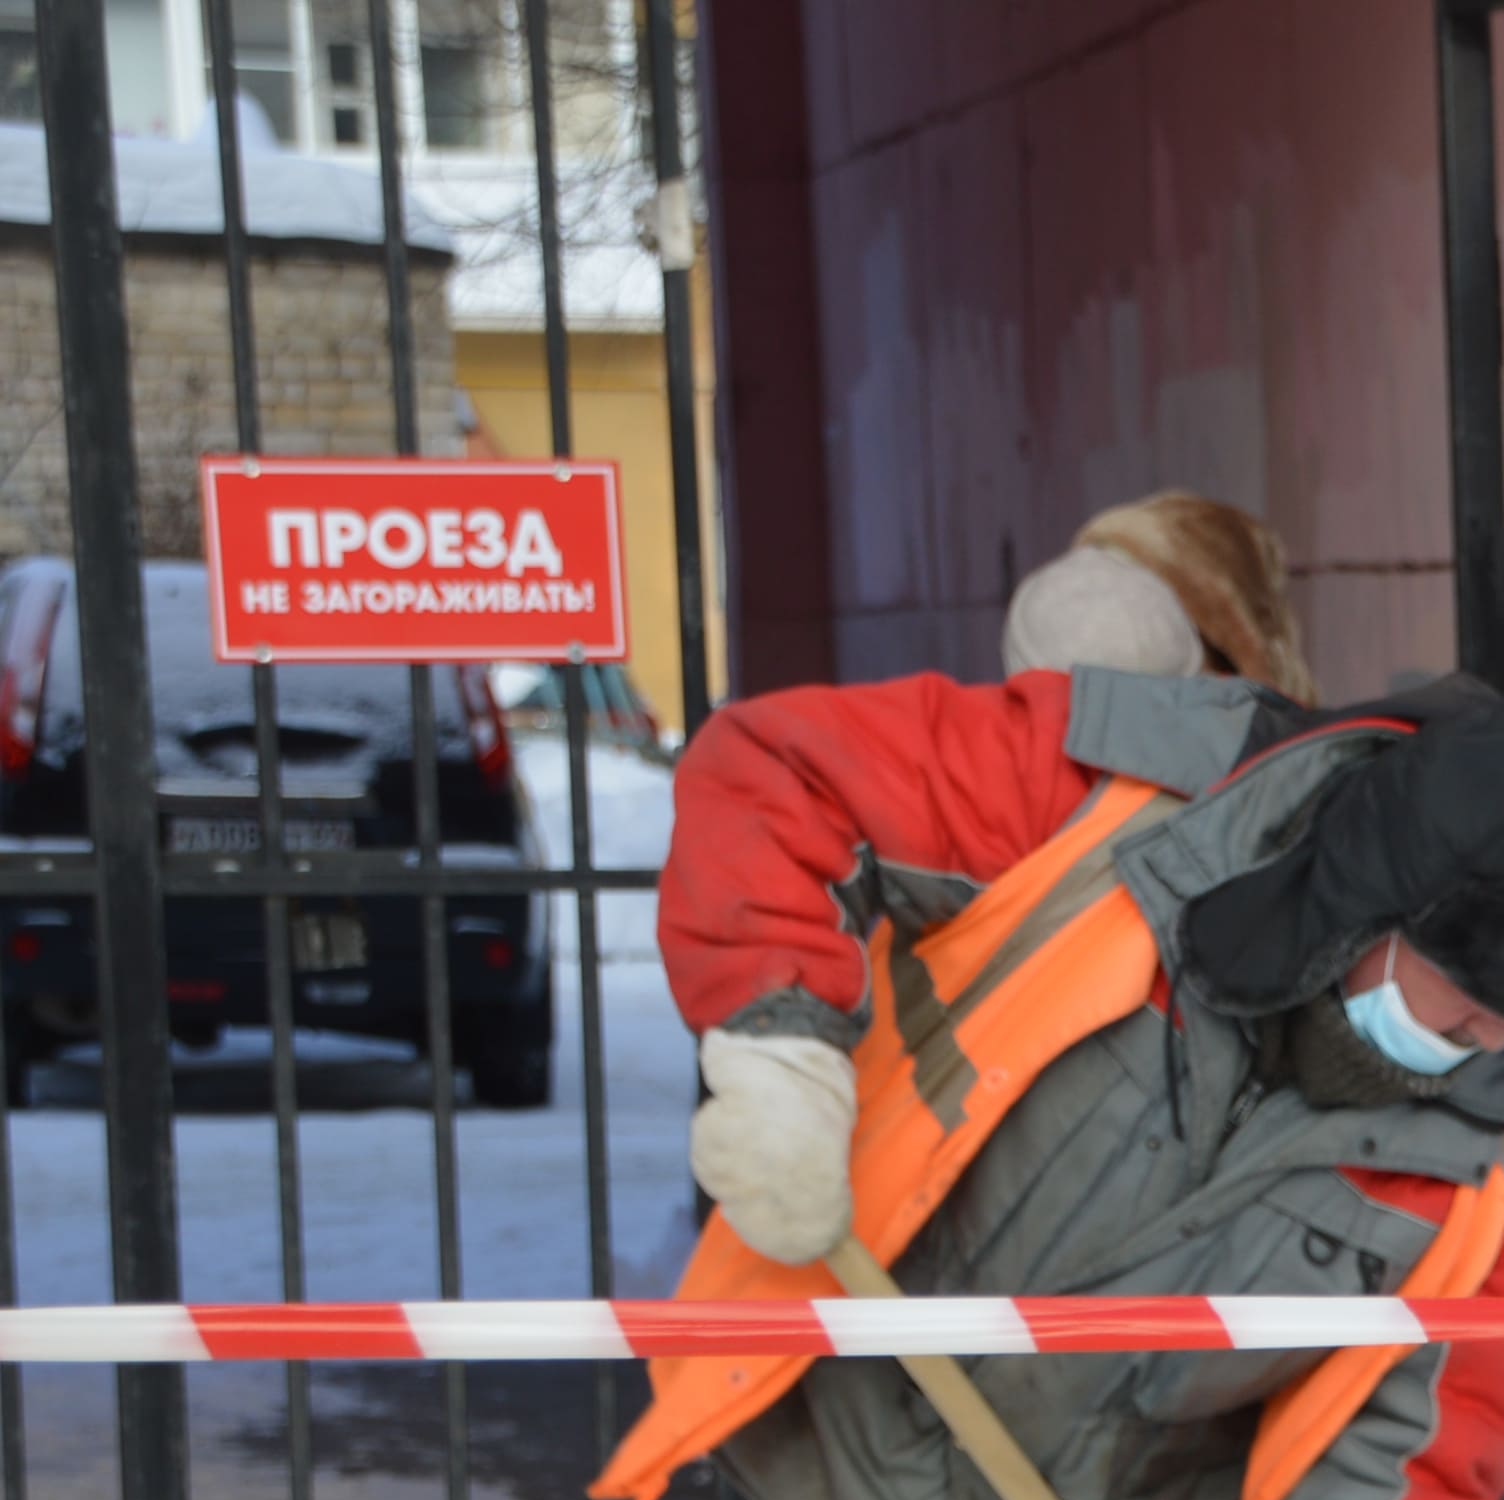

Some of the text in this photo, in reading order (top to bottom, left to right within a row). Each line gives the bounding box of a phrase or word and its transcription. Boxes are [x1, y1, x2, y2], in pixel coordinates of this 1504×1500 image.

[267, 508, 563, 578] ПРОЕЗД
[241, 580, 595, 614] НЕ ЗАГОРАЖИВАТЬ!
